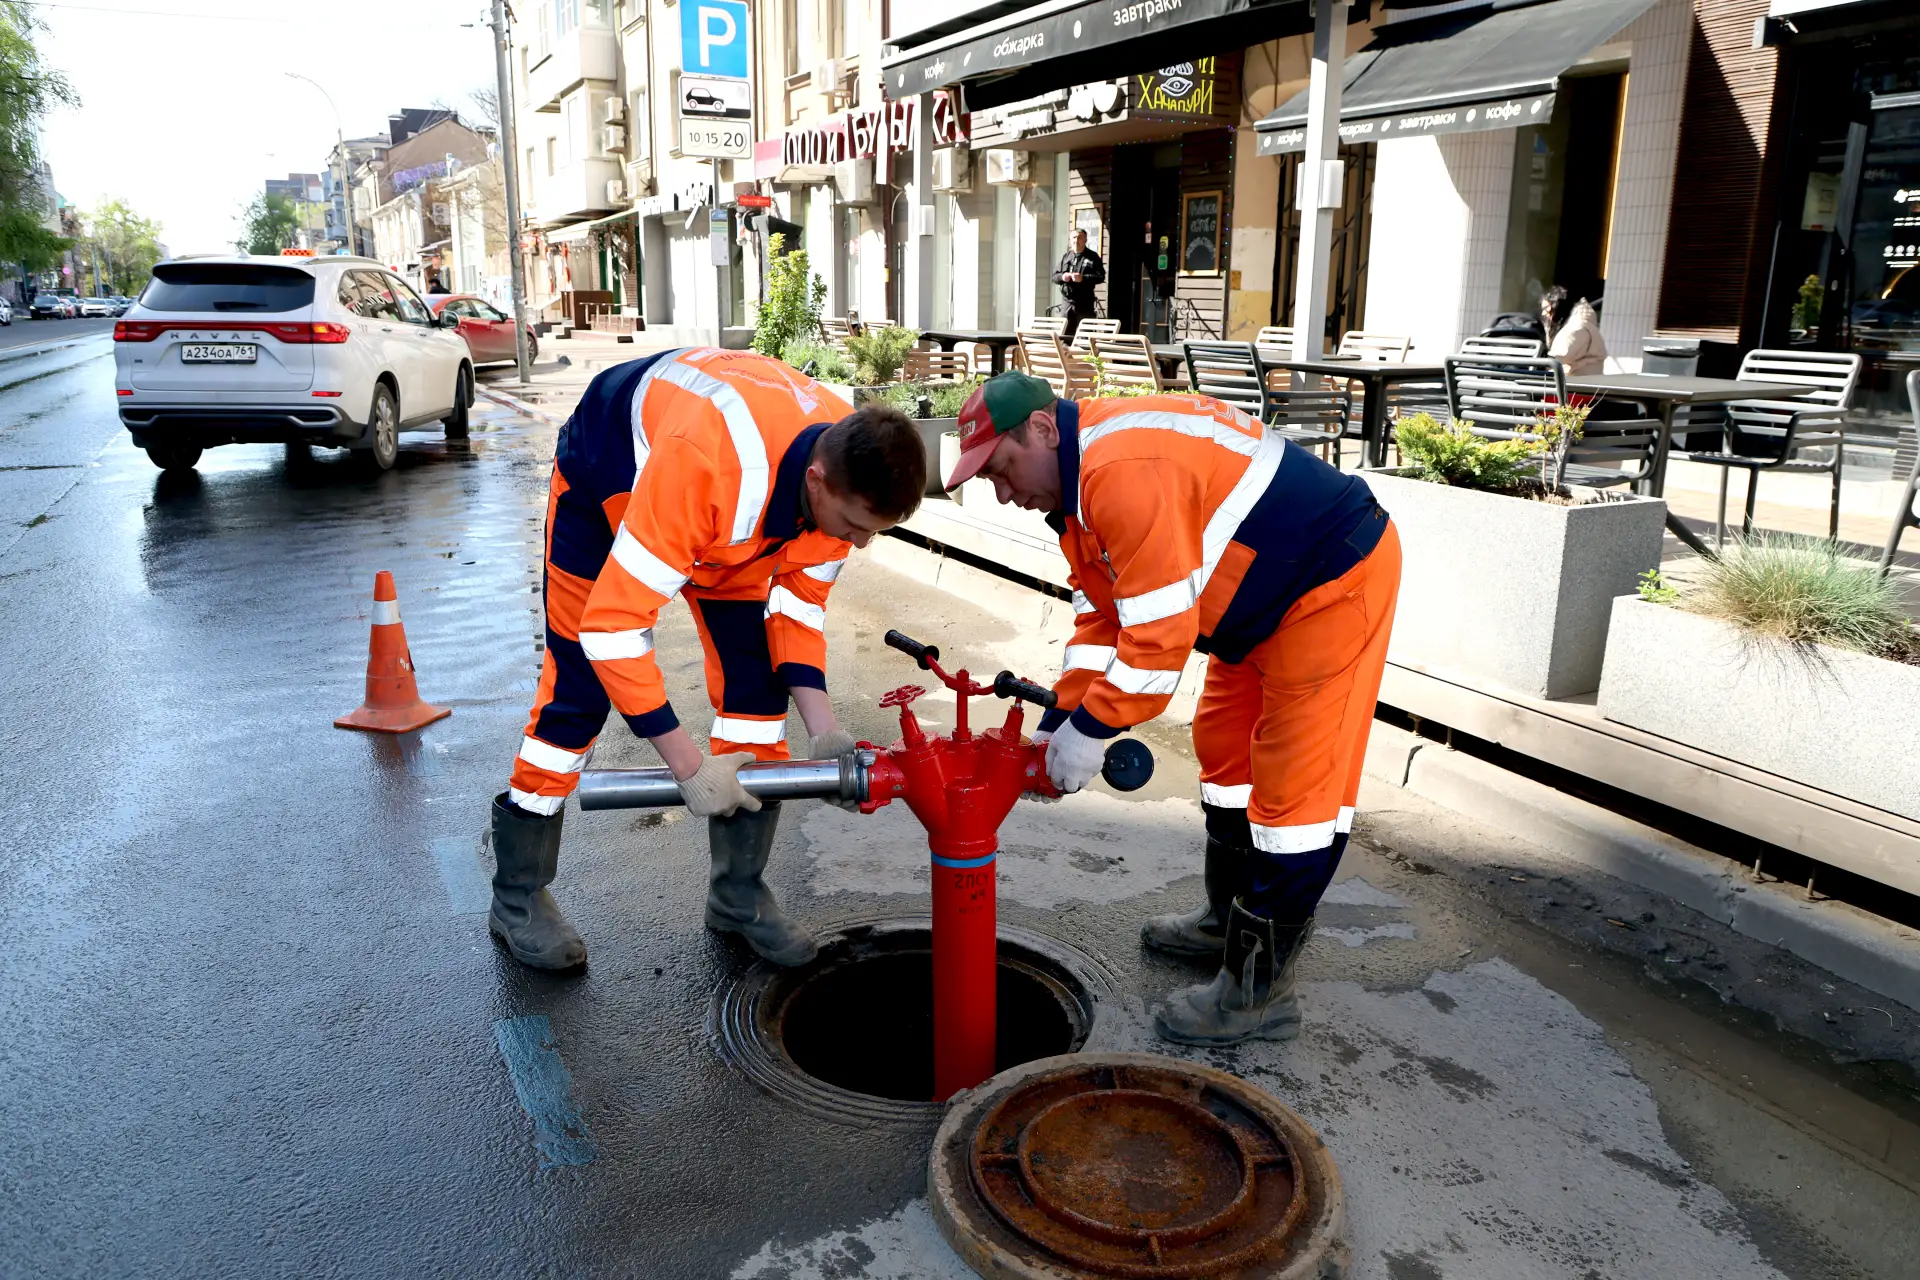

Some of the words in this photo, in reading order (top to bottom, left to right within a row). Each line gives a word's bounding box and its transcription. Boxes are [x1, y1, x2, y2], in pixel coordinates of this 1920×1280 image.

[700, 6, 736, 67] P
[924, 57, 946, 80] кофе
[993, 32, 1044, 57] обжарка
[1277, 129, 1304, 146] кофе
[1398, 112, 1457, 130] завтраки
[1486, 100, 1522, 120] кофе
[689, 132, 701, 143] 10
[705, 133, 719, 144] 15
[723, 132, 744, 147] 20
[170, 332, 260, 340] HAVAL
[235, 346, 254, 356] 761
